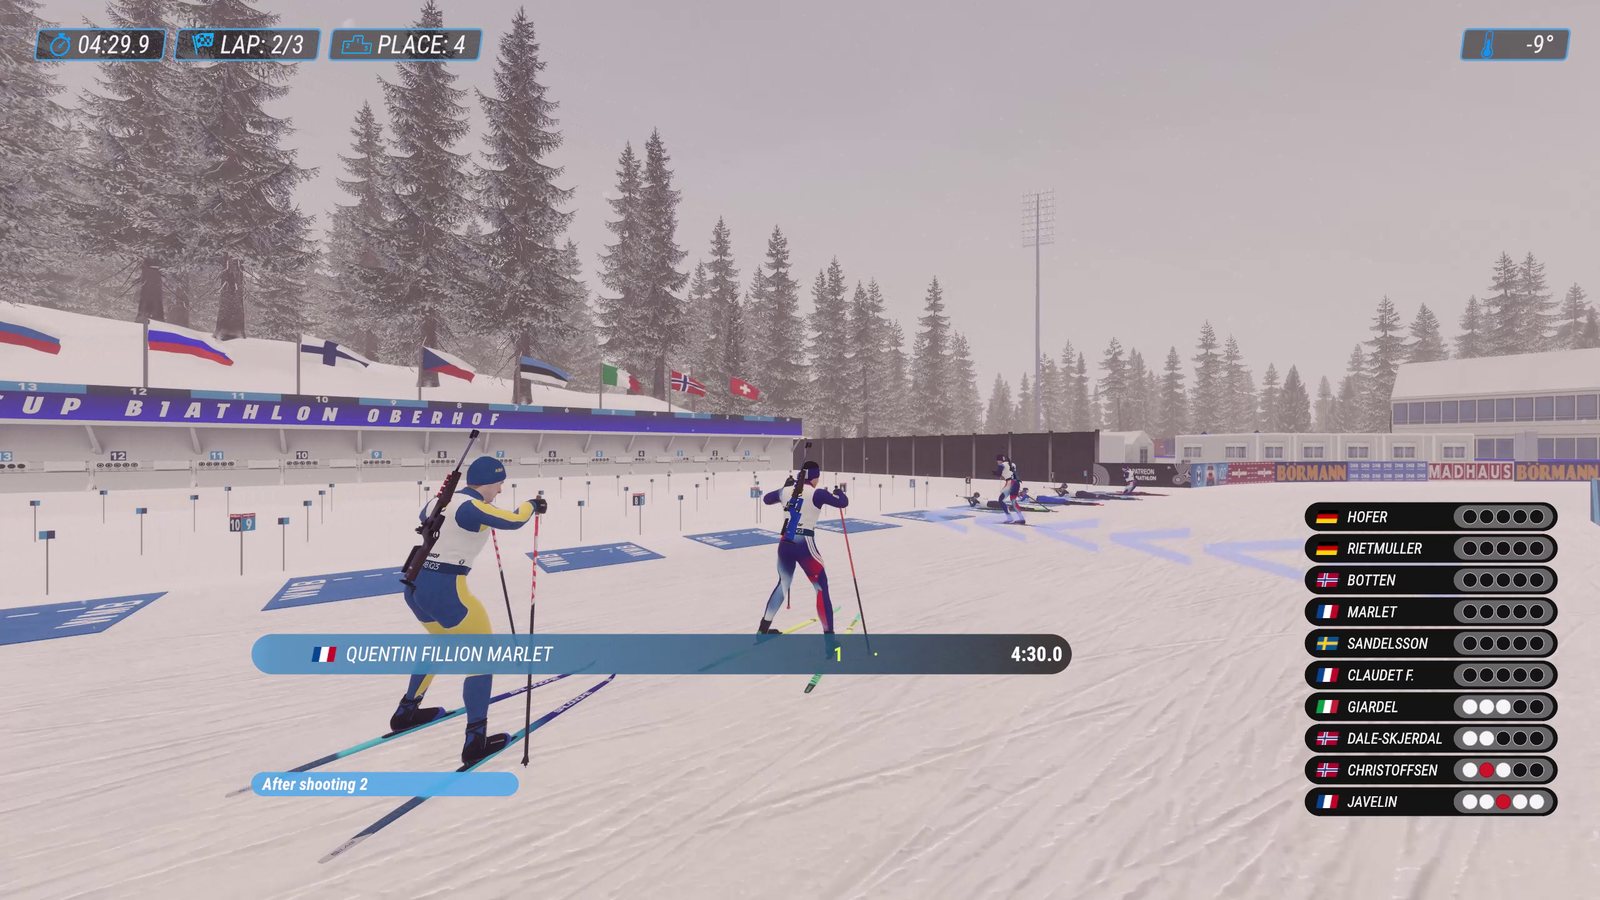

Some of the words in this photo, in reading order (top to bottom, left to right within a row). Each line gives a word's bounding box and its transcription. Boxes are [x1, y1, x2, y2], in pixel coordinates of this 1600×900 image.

[18, 382, 38, 391] 13
[130, 387, 148, 396] 12
[231, 392, 245, 400] 11
[0, 394, 82, 415] UP
[367, 408, 500, 426] OBERHOF
[111, 452, 126, 460] 12
[210, 452, 223, 460] 11
[296, 451, 308, 460] 10
[1428, 464, 1512, 480] MADHAUS
[230, 519, 240, 531] 10
[246, 518, 252, 530] 9
